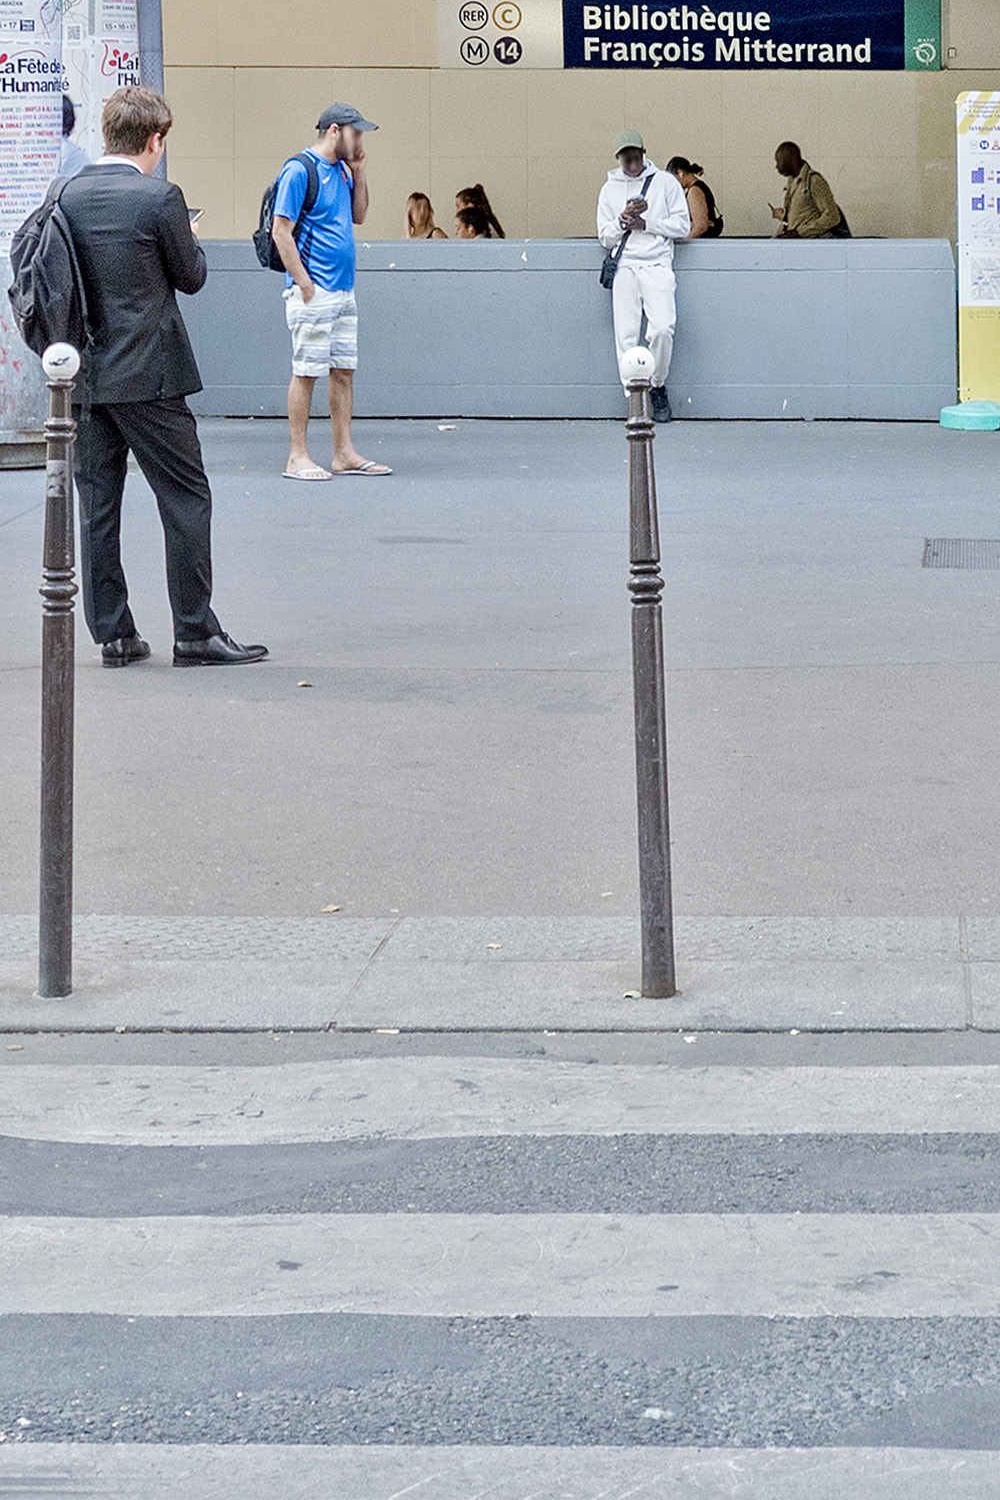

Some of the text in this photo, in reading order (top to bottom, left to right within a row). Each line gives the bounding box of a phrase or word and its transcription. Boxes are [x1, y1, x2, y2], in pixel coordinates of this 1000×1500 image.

[463, 9, 514, 24] RER C
[583, 4, 771, 37] Bibliothèque
[467, 41, 519, 60] M 14
[583, 36, 872, 67] François Mitterrand
[17, 58, 49, 74] Fête
